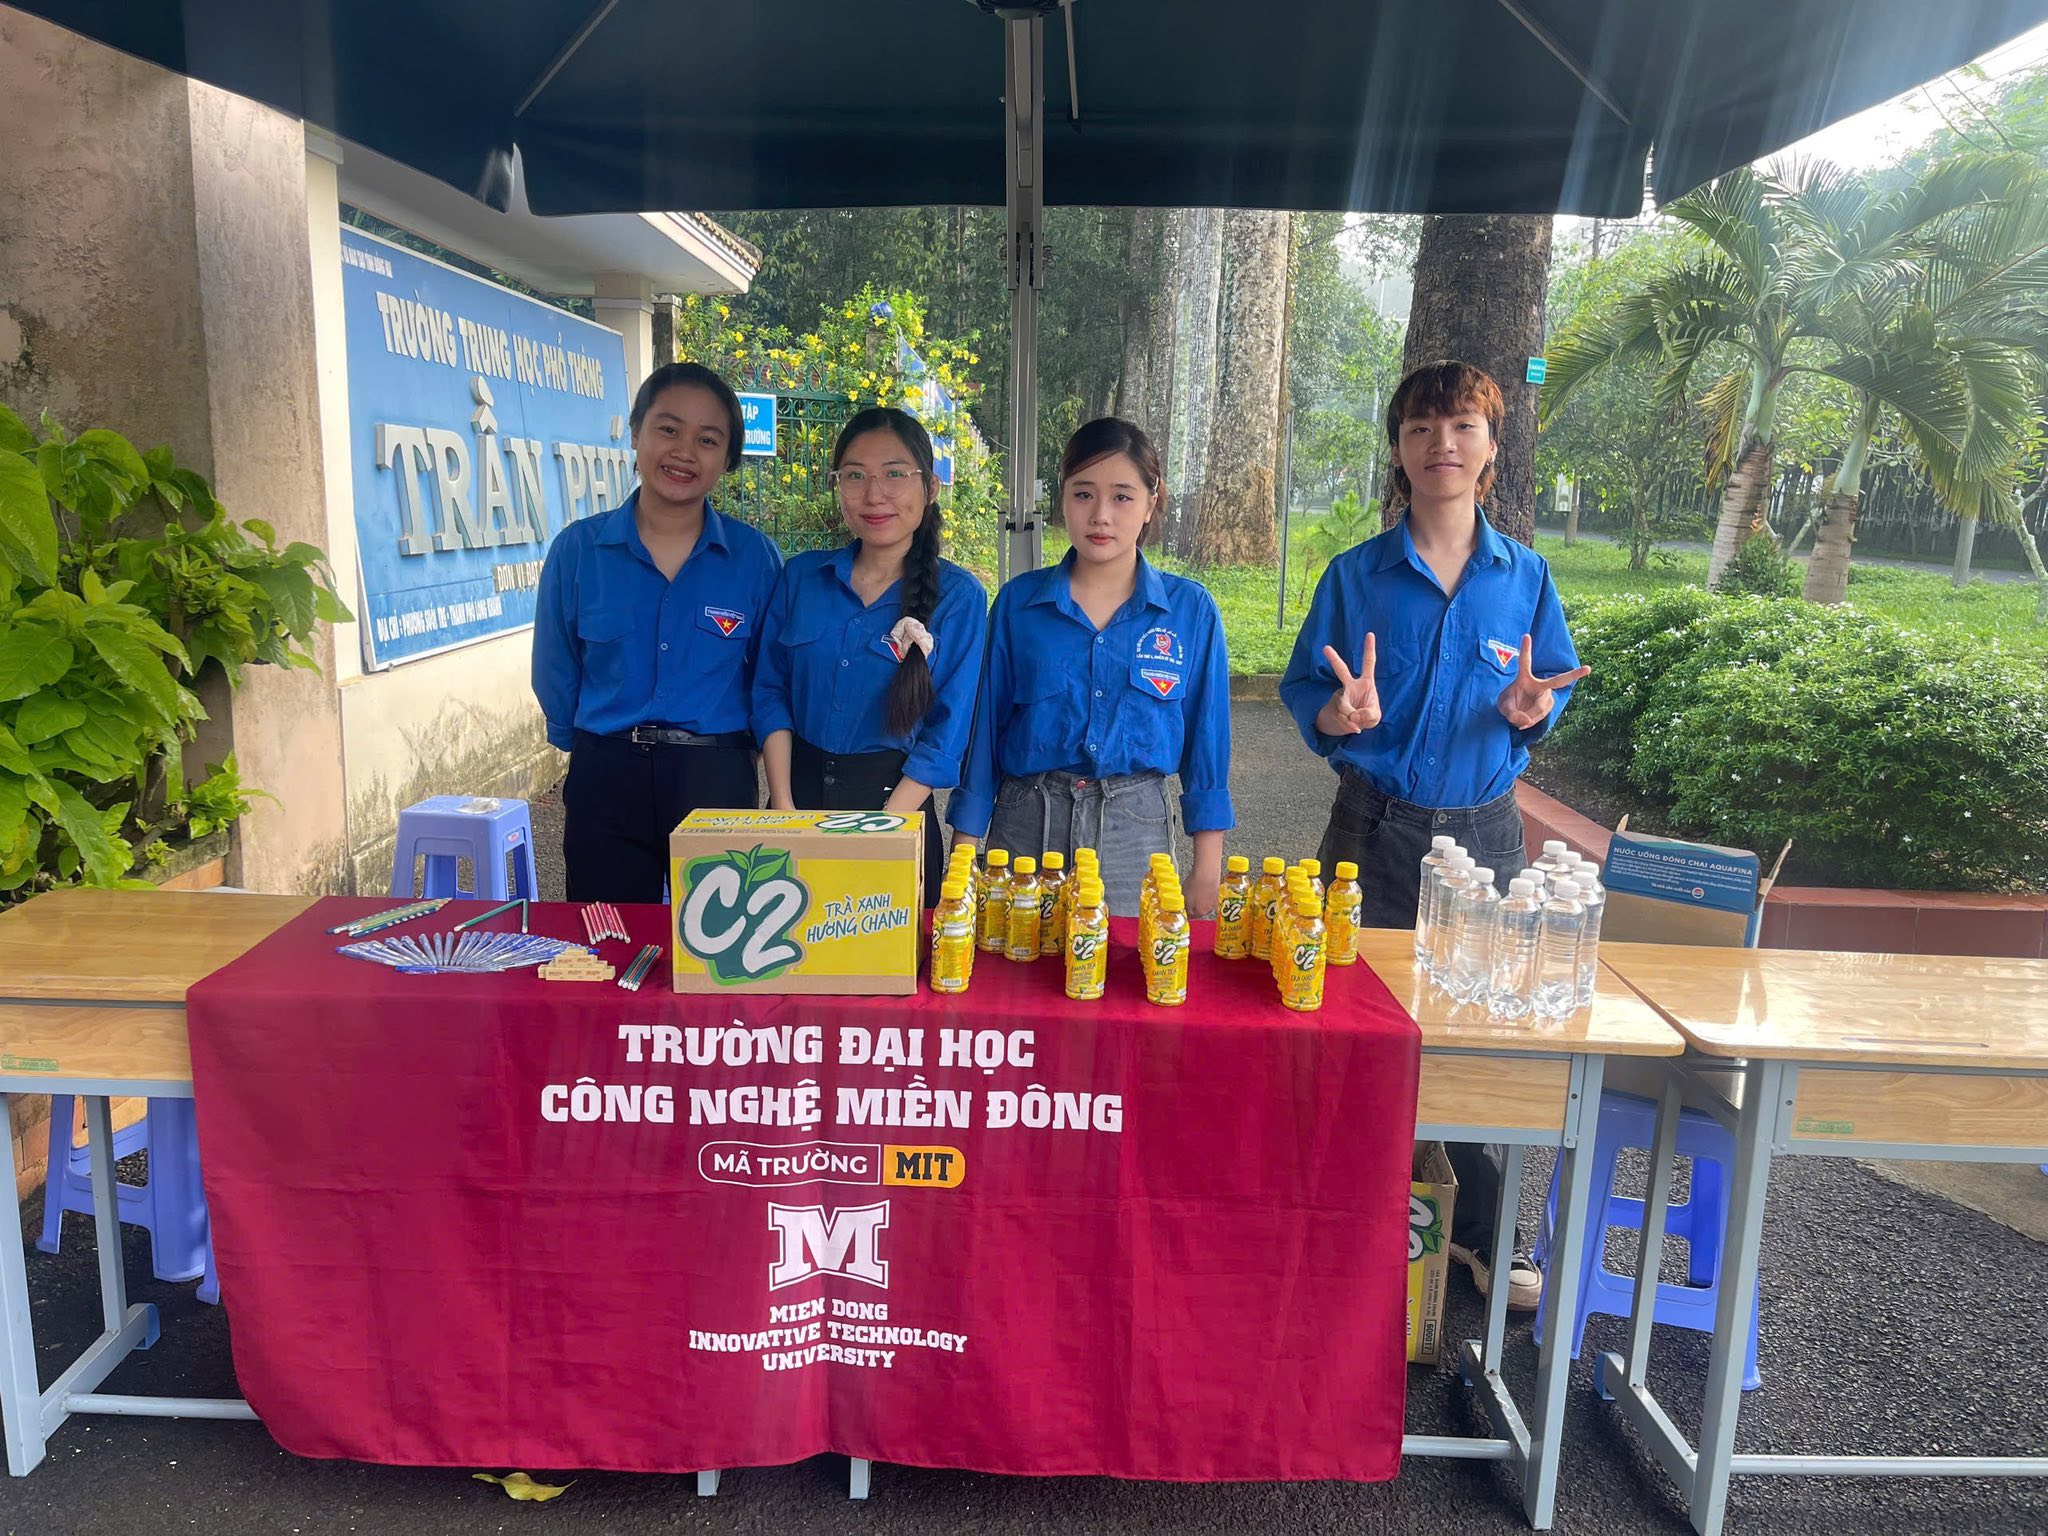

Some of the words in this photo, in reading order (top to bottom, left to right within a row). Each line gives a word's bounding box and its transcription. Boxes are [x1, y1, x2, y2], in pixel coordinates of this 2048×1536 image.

[376, 289, 457, 368] TRƯỜNG
[457, 316, 512, 380] TRUNG
[512, 334, 543, 397] HỌC
[541, 331, 568, 393] PHỔ
[567, 344, 605, 401] THÔNG
[741, 402, 759, 423] TẬP
[744, 428, 771, 446] RƯỜNG
[375, 376, 549, 556] TRẦN
[495, 563, 515, 592] ĐƠN
[815, 812, 905, 832] C2
[1613, 846, 1636, 857] NƯỚC
[1637, 849, 1661, 861] UỐNG
[1662, 854, 1686, 865] ĐÓNG
[1687, 859, 1708, 868] CHAI
[1709, 862, 1753, 876] AQUAFINA
[683, 865, 803, 976] C2
[824, 895, 853, 919] TRÀ
[857, 893, 891, 912] XANH
[1220, 899, 1242, 922] C2
[806, 917, 858, 944] HƯƠNG
[861, 908, 909, 933] CHANH
[1071, 934, 1097, 960] C2
[1152, 938, 1177, 965] C2
[1293, 945, 1317, 971] C2
[618, 1019, 823, 1067] TRƯỜNG
[838, 1026, 925, 1073] ĐẠI
[938, 1027, 1036, 1075] HỌC
[540, 1076, 675, 1124] CÔNG
[689, 1078, 822, 1132] NGHỆ
[836, 1073, 973, 1128] MIỀN
[985, 1083, 1124, 1133] ĐÔNG
[713, 1148, 752, 1174] MÃ
[757, 1148, 869, 1177] TRƯỜNG
[895, 1152, 954, 1181] MIT
[768, 1199, 890, 1291] M
[769, 1297, 826, 1324] MIEN
[831, 1298, 889, 1322] DONG
[688, 1322, 821, 1352] INNOVATIVE
[827, 1322, 968, 1354] TECHNOLOGY
[1424, 1323, 1435, 1350] 600017
[762, 1342, 896, 1372] UNIVERSITY
